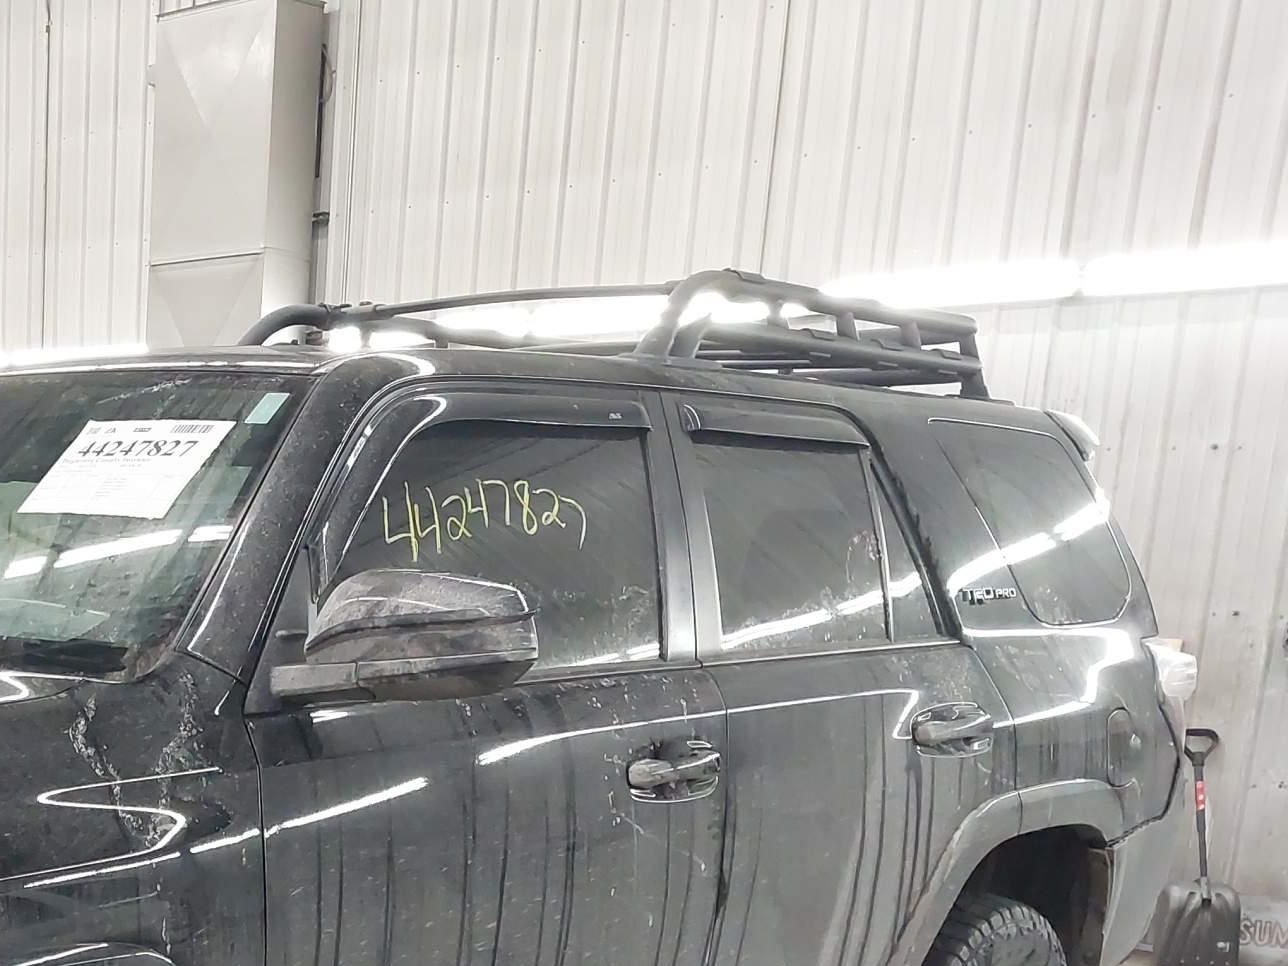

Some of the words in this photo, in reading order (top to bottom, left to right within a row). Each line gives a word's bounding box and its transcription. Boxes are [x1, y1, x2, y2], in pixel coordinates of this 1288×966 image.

[78, 439, 199, 457] 44247827
[382, 478, 587, 562] 44247827
[995, 587, 1017, 599] PRO
